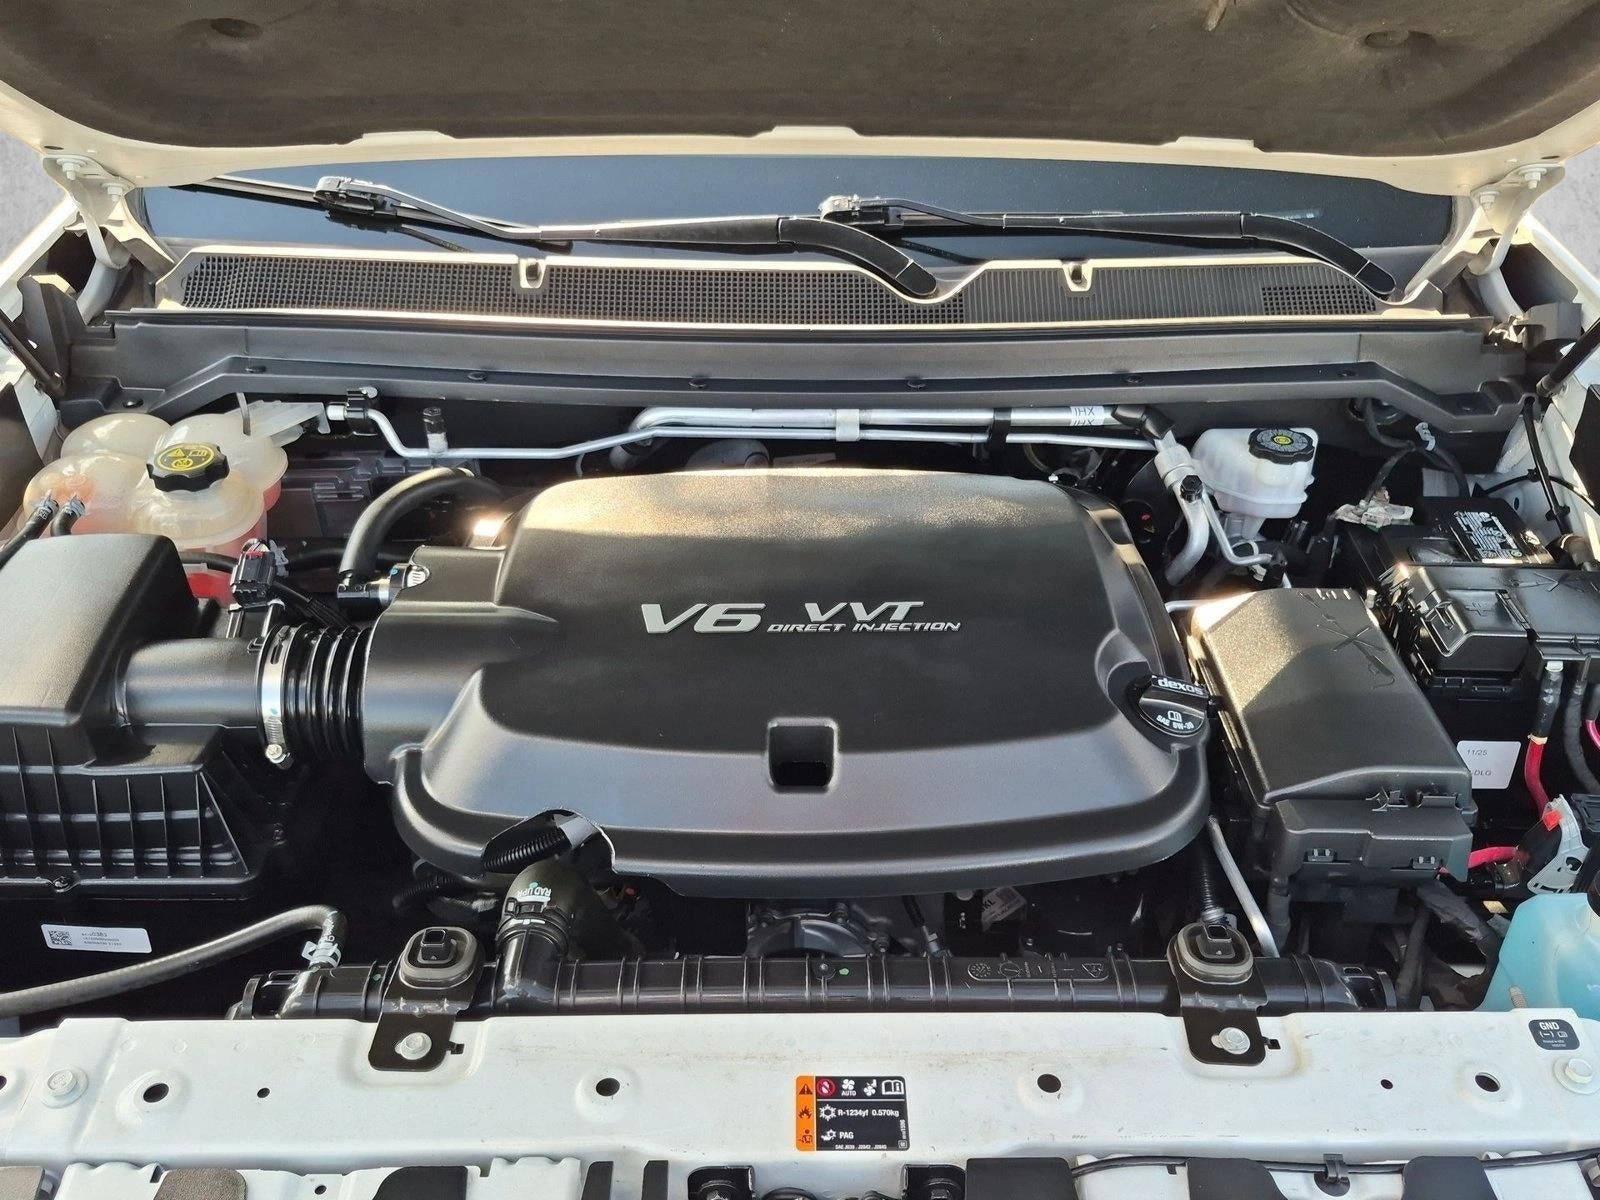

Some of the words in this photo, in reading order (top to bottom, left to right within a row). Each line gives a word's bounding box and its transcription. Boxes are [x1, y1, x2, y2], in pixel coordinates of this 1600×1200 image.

[641, 603, 766, 633] V6
[804, 601, 924, 622] VVT
[767, 623, 846, 633] DIRECT
[851, 622, 961, 633] INJECTION
[1157, 677, 1204, 695] dexos
[1539, 1021, 1560, 1030] GND
[837, 1109, 869, 1118] R-1234yf
[871, 1109, 900, 1118] 0.570kg
[839, 1131, 854, 1139] PAG
